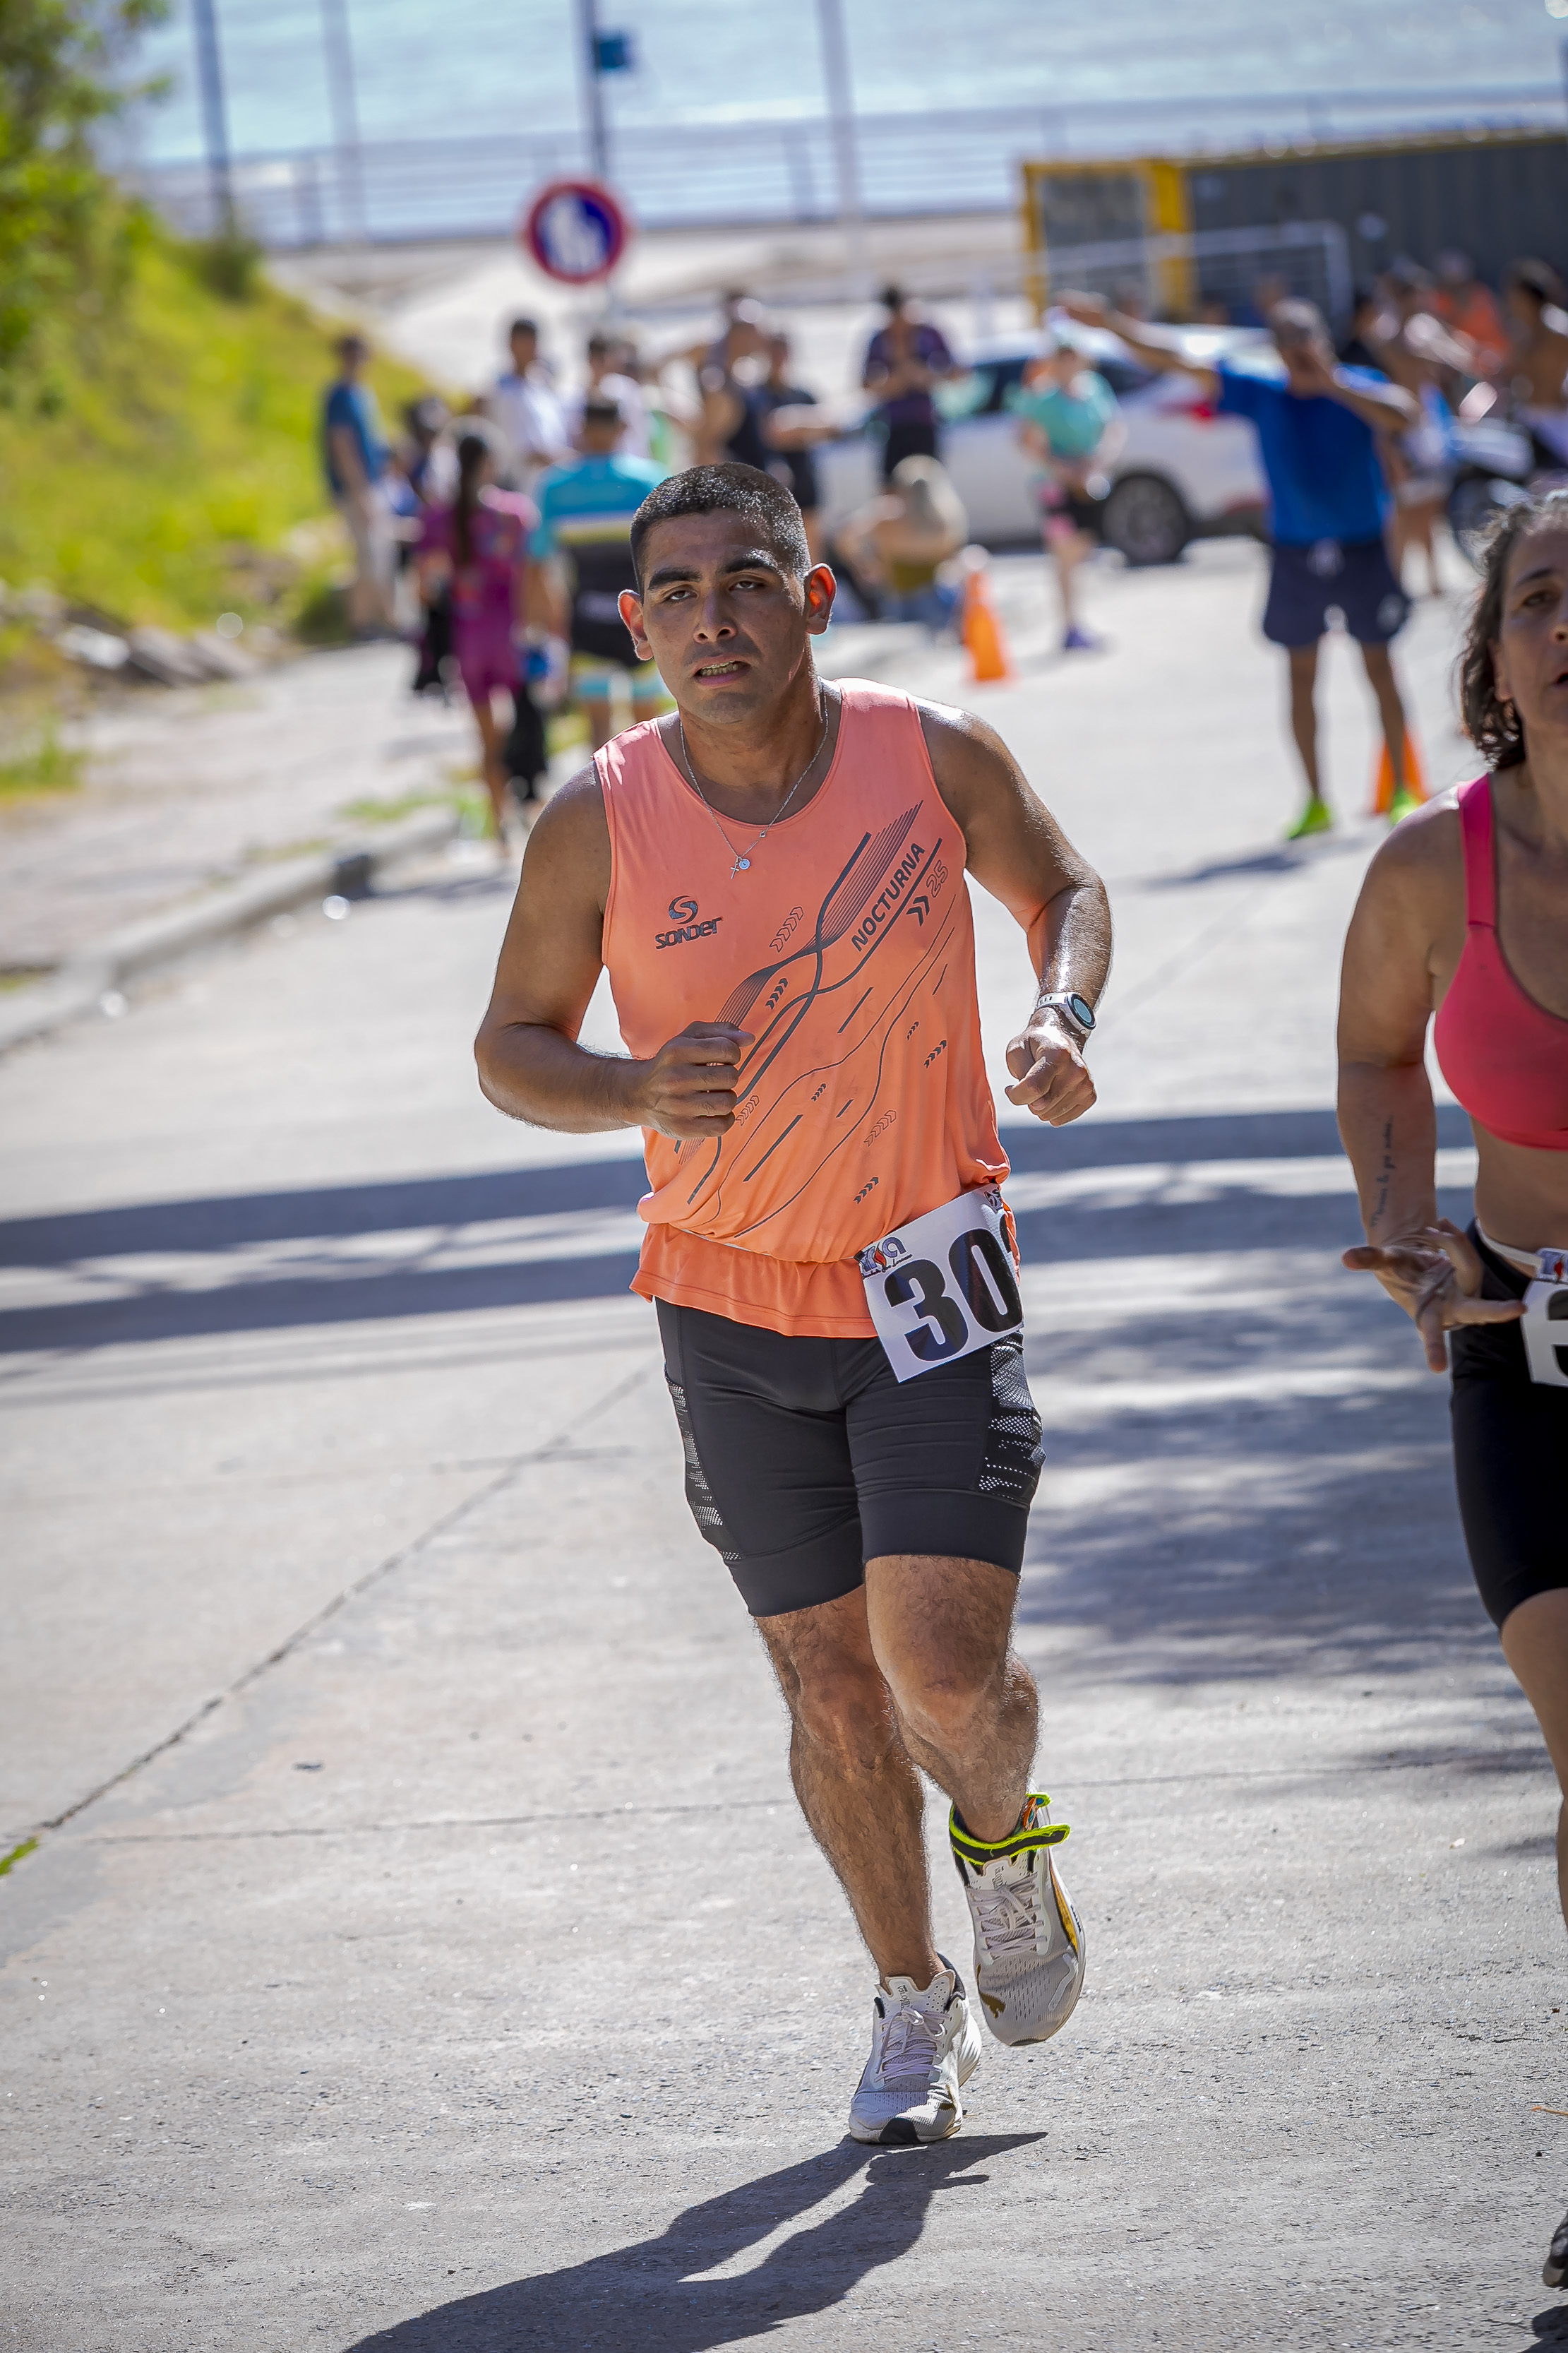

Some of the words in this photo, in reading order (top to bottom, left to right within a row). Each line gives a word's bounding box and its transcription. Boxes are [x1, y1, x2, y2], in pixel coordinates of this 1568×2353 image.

[851, 843, 926, 952] NOCTURNA
[926, 859, 949, 898] 25
[885, 1215, 1023, 1361] 30
